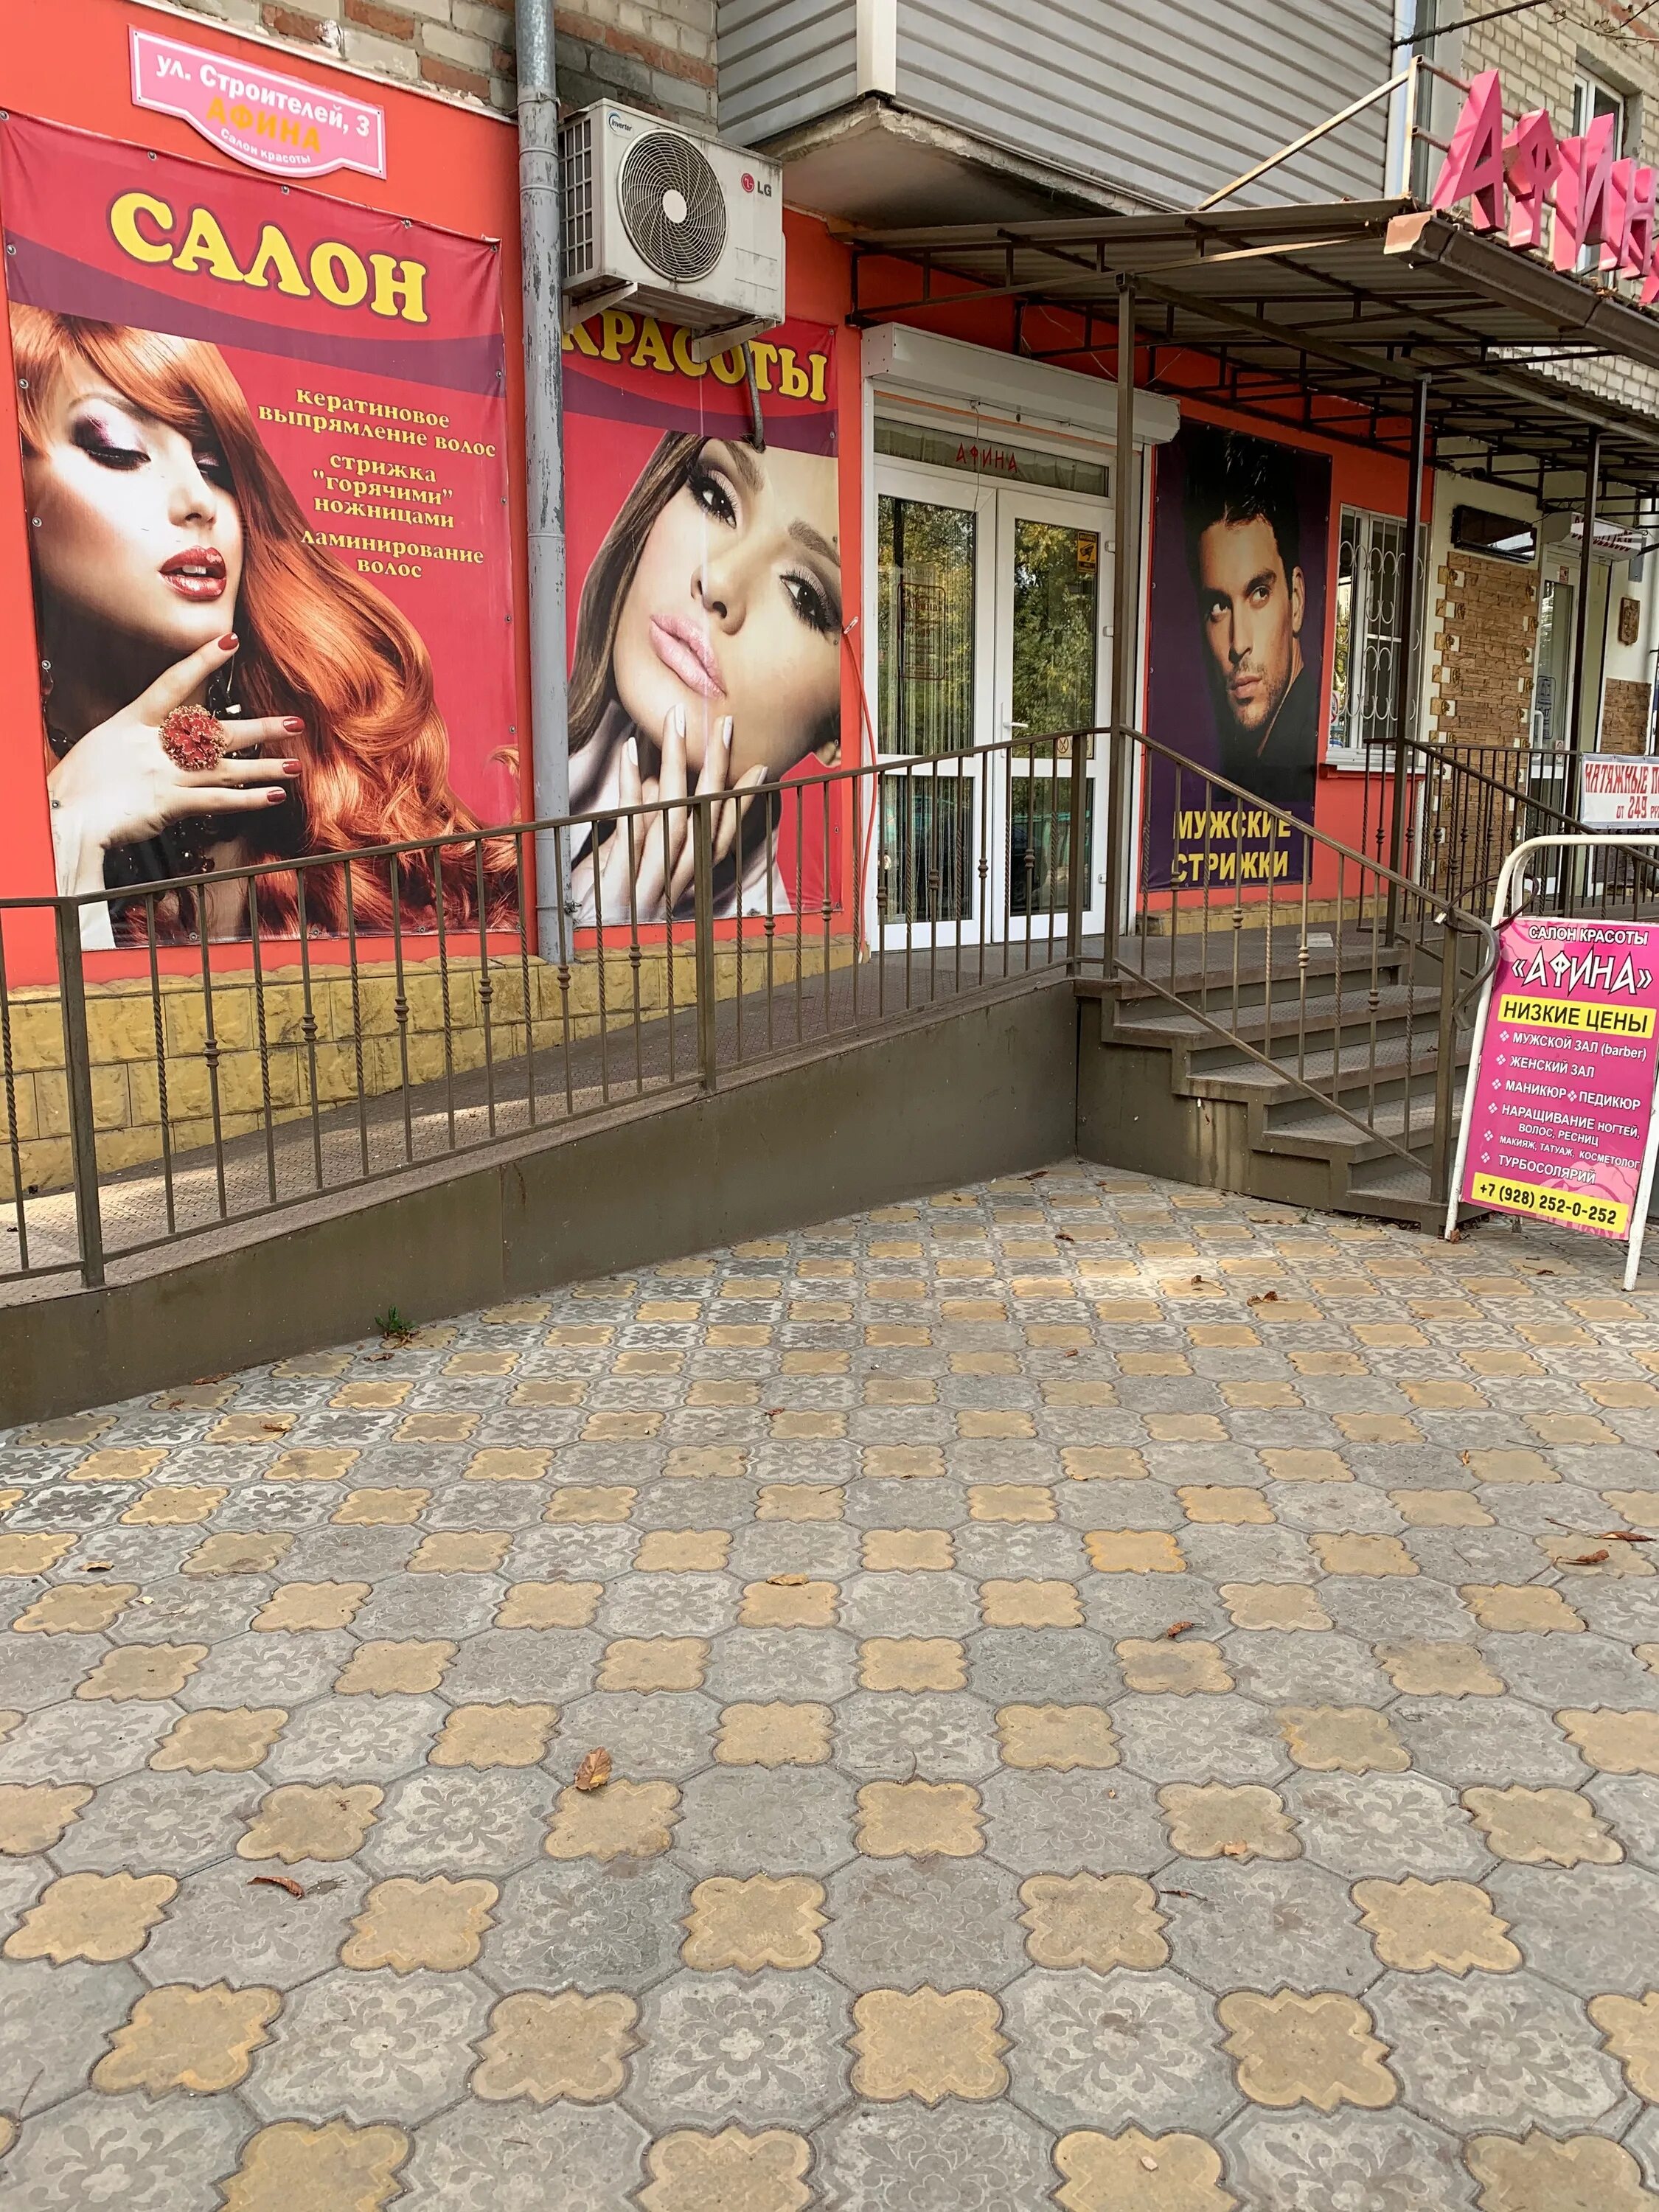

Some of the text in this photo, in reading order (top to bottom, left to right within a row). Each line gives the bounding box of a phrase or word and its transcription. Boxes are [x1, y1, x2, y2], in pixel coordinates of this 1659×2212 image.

[156, 55, 370, 137] ул. Строителей, 3
[206, 96, 321, 153] АФИНА
[611, 119, 632, 131] Inverter
[220, 128, 310, 164] Салон красоты
[757, 181, 772, 197] LG
[1430, 68, 1659, 306] АФИН
[110, 192, 428, 323] САЛОН
[296, 389, 450, 428] кератиновое
[259, 406, 495, 457] выпрямление волос
[330, 454, 437, 482] стрижка
[956, 442, 1017, 473] АФИНА
[313, 469, 453, 505] "горячими"
[313, 497, 454, 528] ножницами
[301, 530, 484, 564] ламинирование
[357, 559, 422, 578] волос
[1585, 763, 1649, 794] НАТЯЖНЫЕ
[1628, 796, 1648, 818] 249
[1172, 810, 1292, 839] МУЖСКИЕ
[1172, 851, 1288, 882] СТРИЖКИ
[1528, 925, 1649, 945] САЛОН КРАСОТЫ
[1511, 945, 1653, 997] «АФИНА»
[1503, 1001, 1648, 1033] НИЗКИЕ ЦЕНЫ
[1512, 1032, 1647, 1062] МУЖСКОЙ ЗАЛ (barber)
[1510, 1055, 1595, 1078] ЖЕНСКИЙ ЗАЛ
[1506, 1080, 1641, 1111] МАНИКЮР ПЕДИКЮР
[1501, 1104, 1640, 1139] НАРАЩИВАНИЕ НОГТЕЙ,
[1518, 1123, 1599, 1147] ВОЛОС, РЕСНИЦ
[1499, 1135, 1641, 1169] МАКИЯЖ, ТАТУАЖ, КОСМЕТОЛОГ
[1498, 1155, 1596, 1184] ТУРБОСОЛЯРИЙ
[1480, 1183, 1617, 1225] +7 (928) 252-0-252
